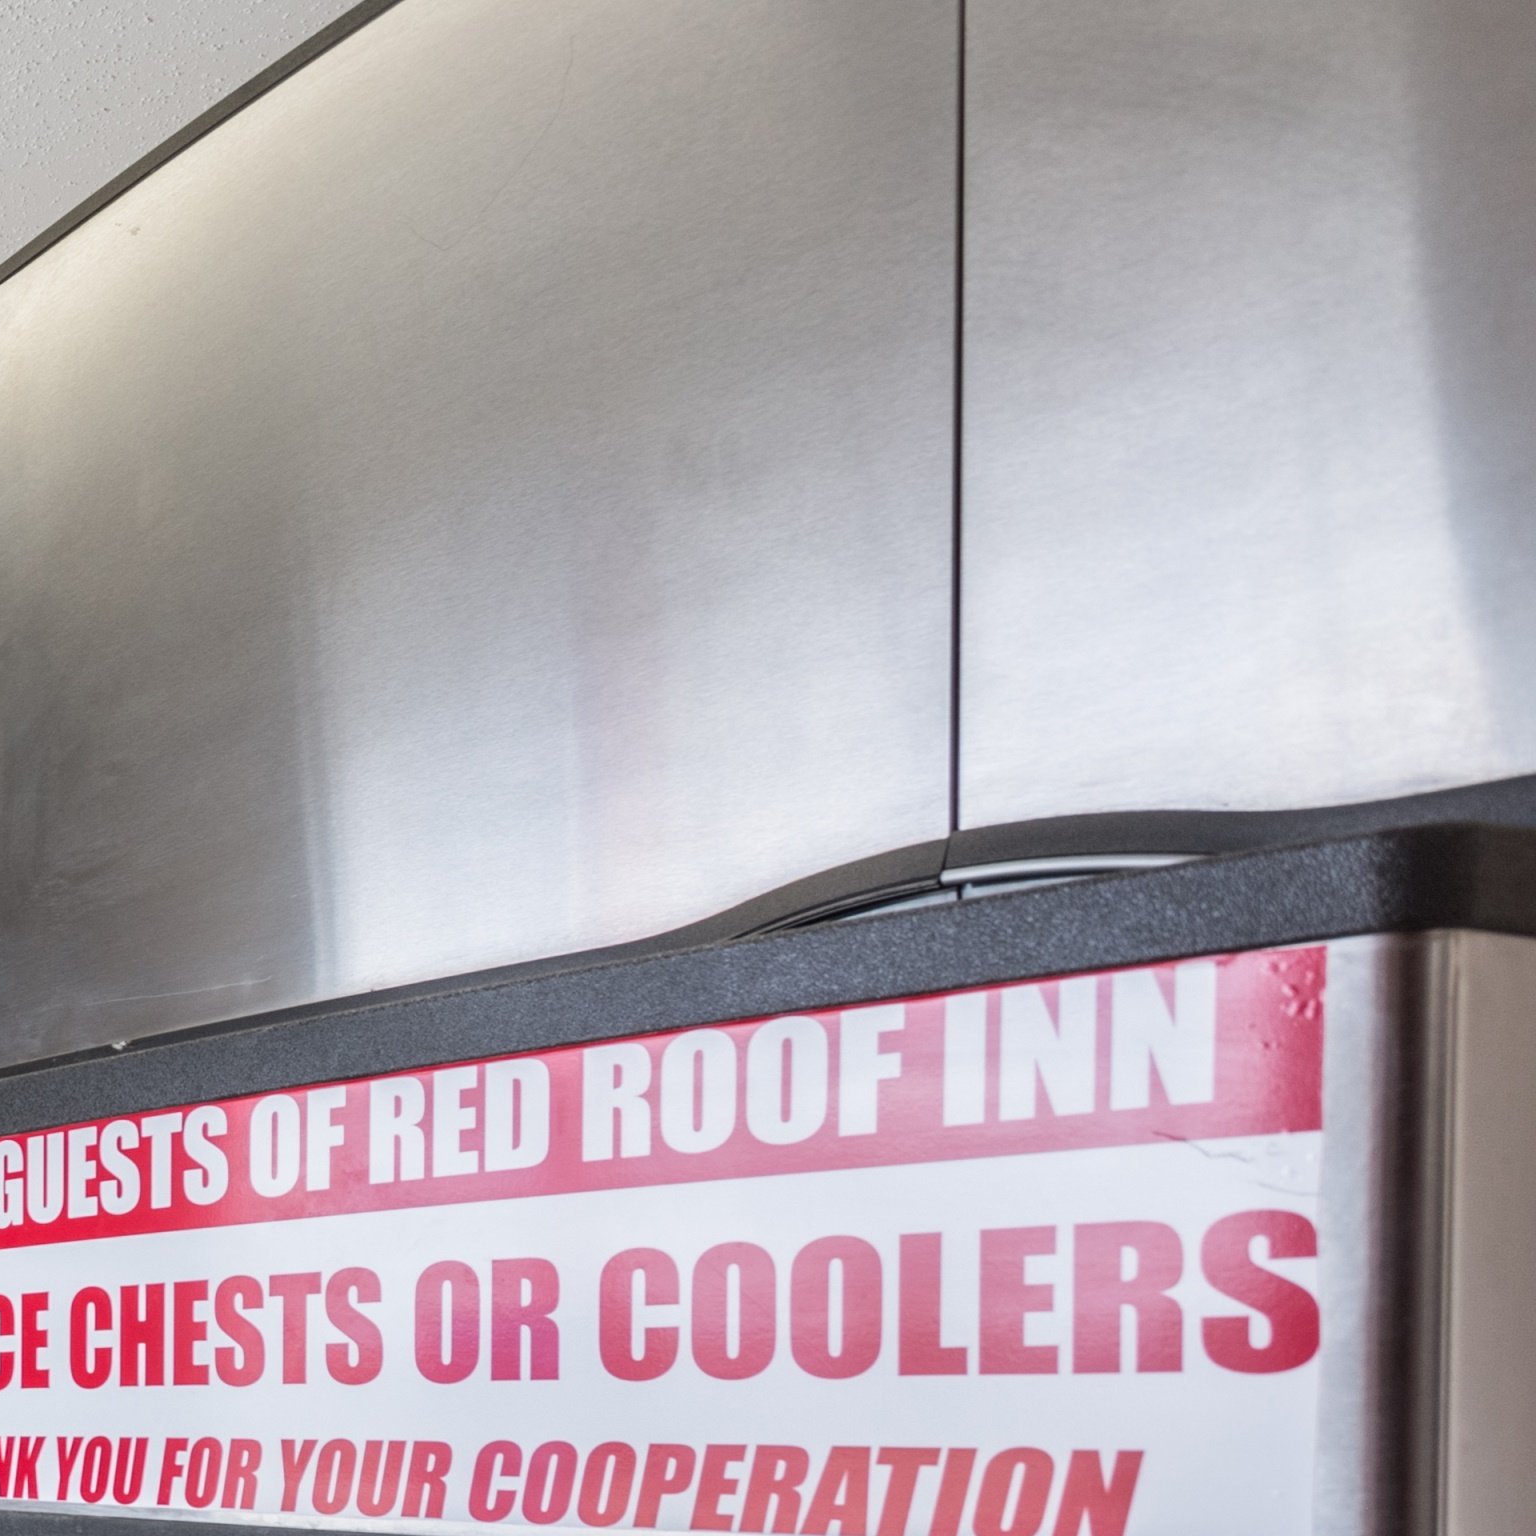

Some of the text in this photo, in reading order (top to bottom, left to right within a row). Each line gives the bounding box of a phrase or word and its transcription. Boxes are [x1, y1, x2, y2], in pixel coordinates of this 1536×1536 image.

[249, 1084, 347, 1199] OF
[368, 1058, 550, 1185] RED
[582, 1002, 907, 1163] ROOF
[943, 961, 1217, 1128] INN
[70, 1266, 384, 1391] CHESTS
[414, 1257, 561, 1385] OR
[598, 1208, 1321, 1382] COOLERS
[56, 1436, 149, 1505] YOU
[157, 1437, 262, 1509] FOR
[280, 1438, 453, 1519] YOUR
